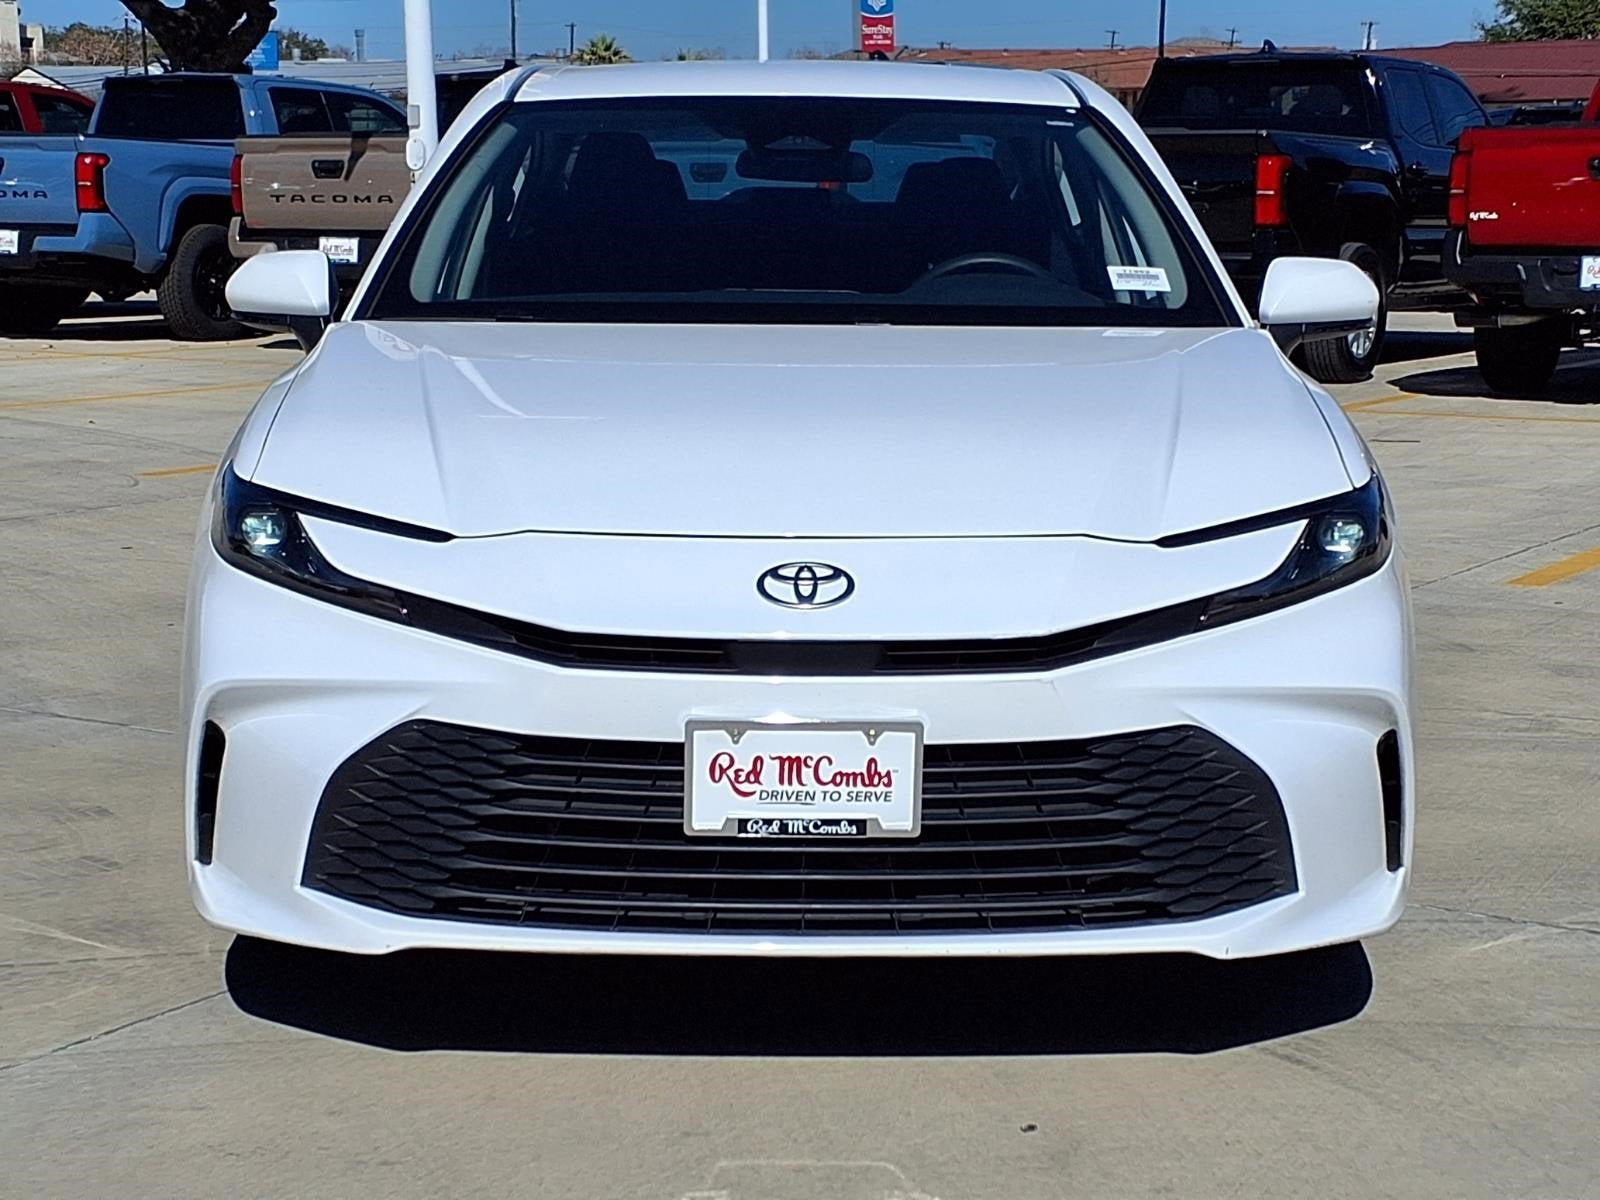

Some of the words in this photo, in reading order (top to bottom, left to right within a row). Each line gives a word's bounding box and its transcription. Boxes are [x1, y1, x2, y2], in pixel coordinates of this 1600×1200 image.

[269, 194, 394, 204] TACOMA
[709, 752, 763, 797] Red
[769, 755, 893, 788] McCombs
[758, 789, 816, 802] DRIVEN
[820, 790, 842, 803] TO
[846, 790, 893, 803] SERVE
[746, 818, 780, 835] Red
